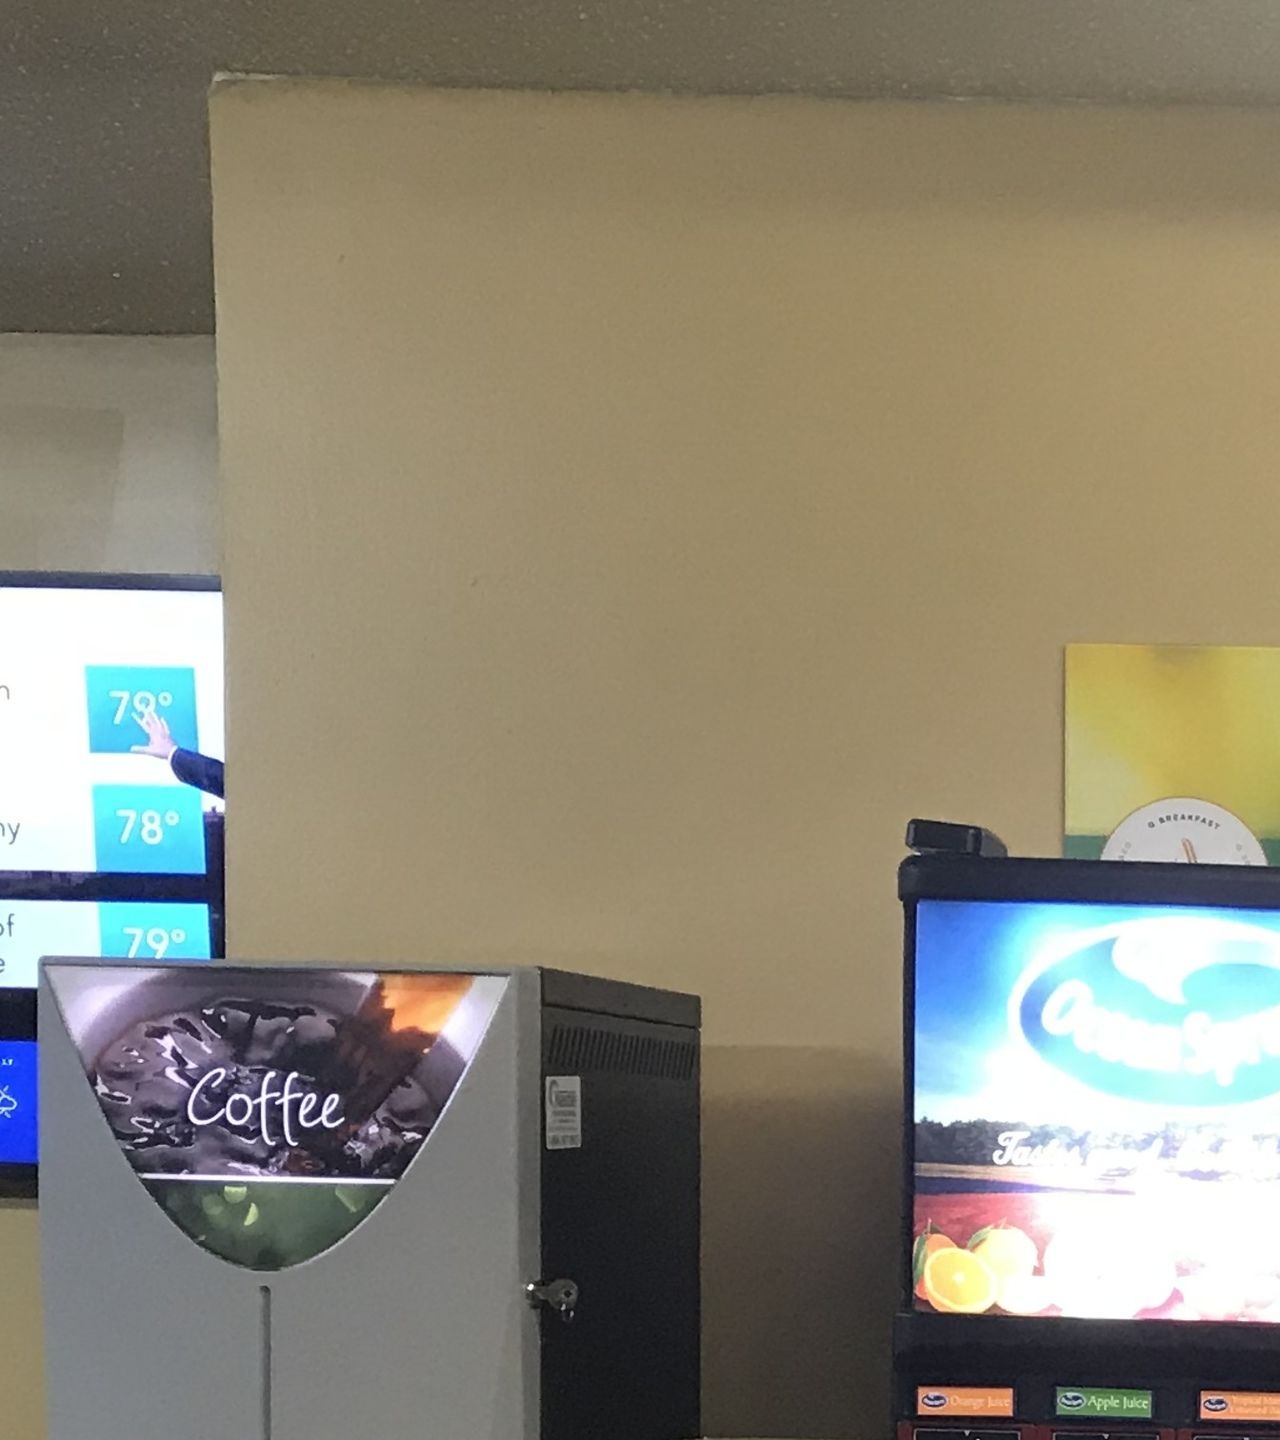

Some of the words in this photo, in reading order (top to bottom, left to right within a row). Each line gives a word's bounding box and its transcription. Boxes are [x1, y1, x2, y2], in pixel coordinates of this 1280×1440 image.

[116, 809, 180, 845] 78°
[1158, 814, 1221, 830] BREAKFAST
[123, 927, 186, 959] 79°
[187, 1068, 345, 1147] Coffee
[950, 1393, 987, 1410] Orange
[988, 1394, 1010, 1409] Juice
[1087, 1394, 1120, 1411] Apple
[1123, 1394, 1149, 1410] Juice
